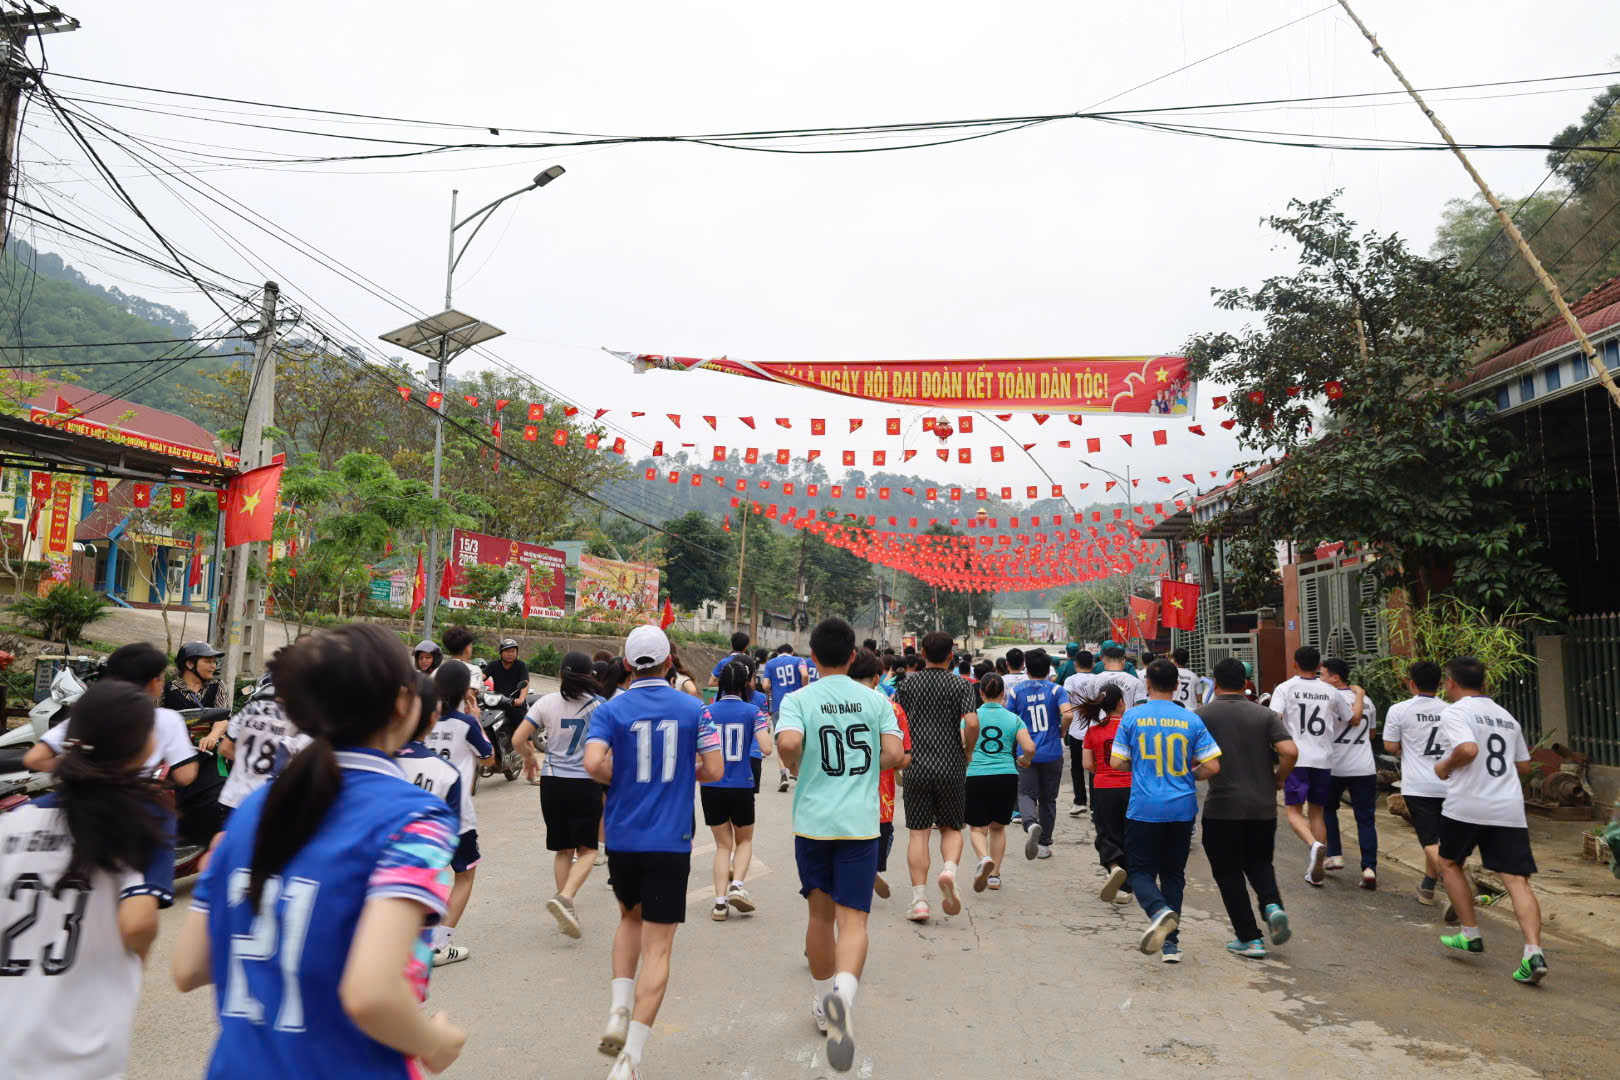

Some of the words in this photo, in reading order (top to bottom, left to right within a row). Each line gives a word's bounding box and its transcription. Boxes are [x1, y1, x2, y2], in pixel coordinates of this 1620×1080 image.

[820, 365, 859, 394] NGÀY
[921, 366, 962, 398] ĐOÀN
[966, 364, 993, 398] KẾT
[998, 366, 1036, 398] TOÀN
[1040, 367, 1071, 398] DÂN
[1074, 367, 1109, 404] TỘC!
[459, 537, 479, 552] 15/3
[776, 664, 796, 687] 99
[808, 667, 821, 683] 2
[1179, 681, 1190, 701] 3
[1303, 692, 1330, 701] Khánh
[1027, 704, 1049, 733] 10
[1136, 717, 1157, 727] MAI
[1298, 703, 1326, 736] 16
[1334, 714, 1369, 745] 22
[560, 718, 587, 756] 7
[629, 719, 679, 783] 11
[818, 723, 872, 777] 05
[980, 725, 1004, 755] 8
[1423, 726, 1446, 760] 4
[243, 733, 276, 775] 18
[1138, 731, 1190, 777] 40
[1486, 733, 1507, 778] 8
[0, 871, 92, 977] 23
